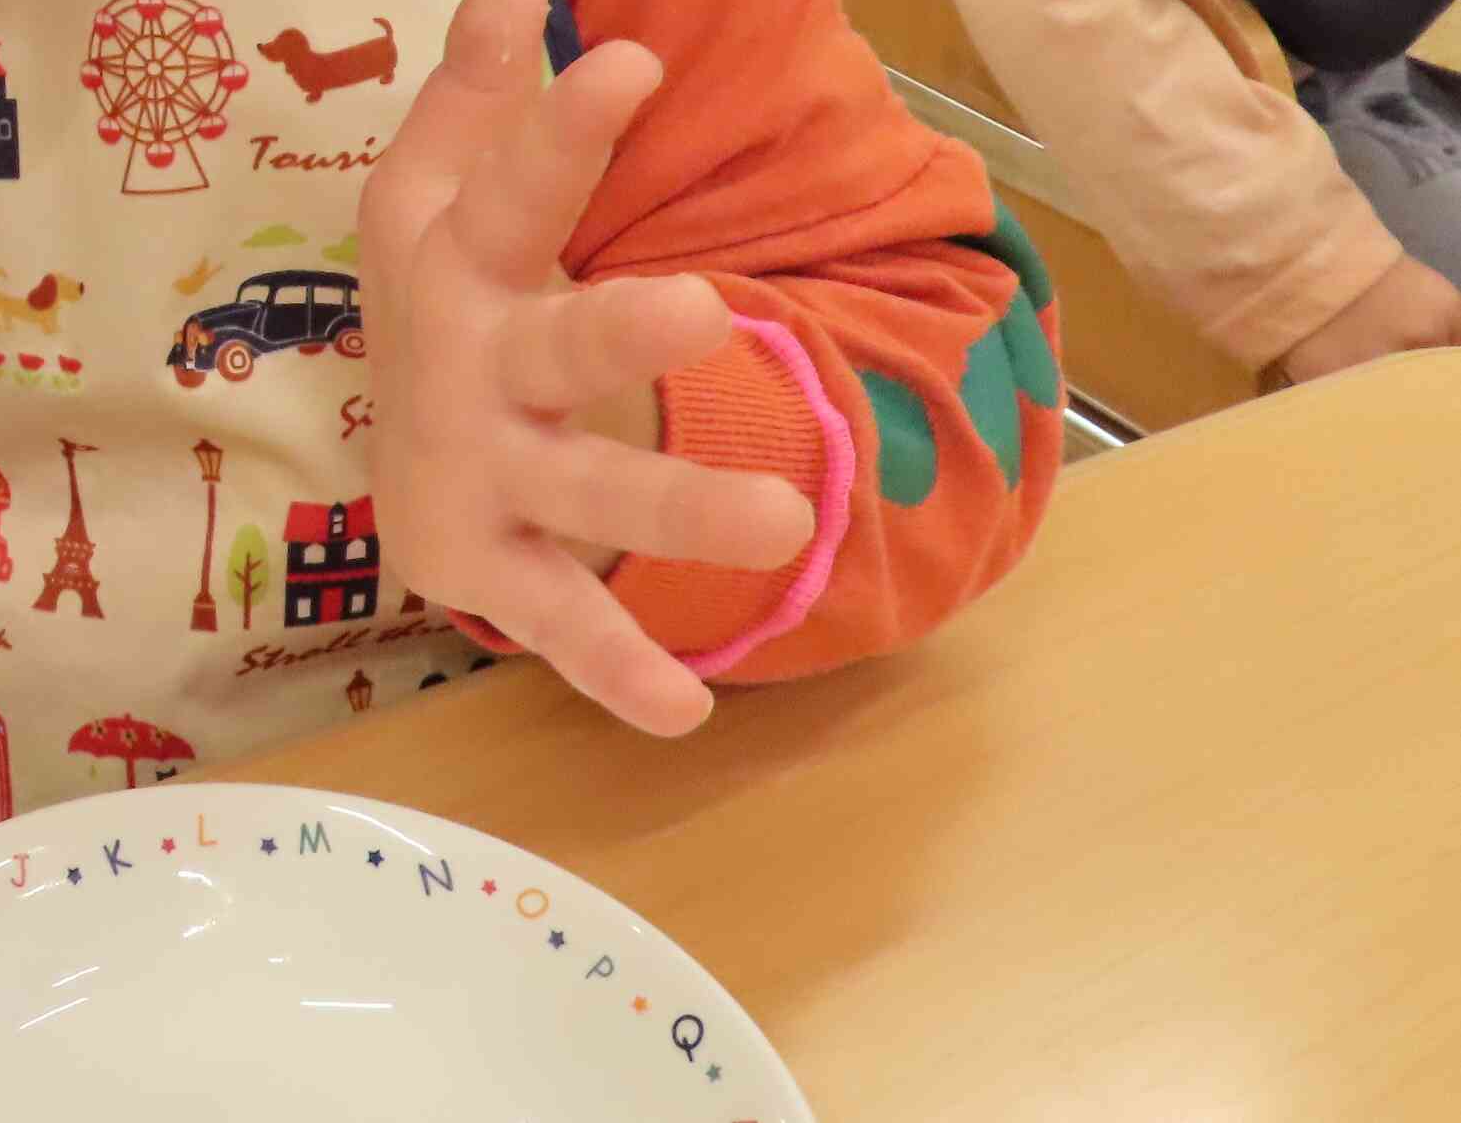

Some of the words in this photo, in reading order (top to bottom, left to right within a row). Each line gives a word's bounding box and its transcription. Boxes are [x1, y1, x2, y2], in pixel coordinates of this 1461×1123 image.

[249, 134, 389, 171] Touri
[11, 853, 30, 888] J
[103, 839, 132, 876] K
[198, 813, 218, 846] L
[299, 821, 331, 855] M
[418, 859, 454, 896] N
[516, 887, 549, 919] O
[585, 955, 614, 980] P
[671, 1014, 704, 1063] Q
